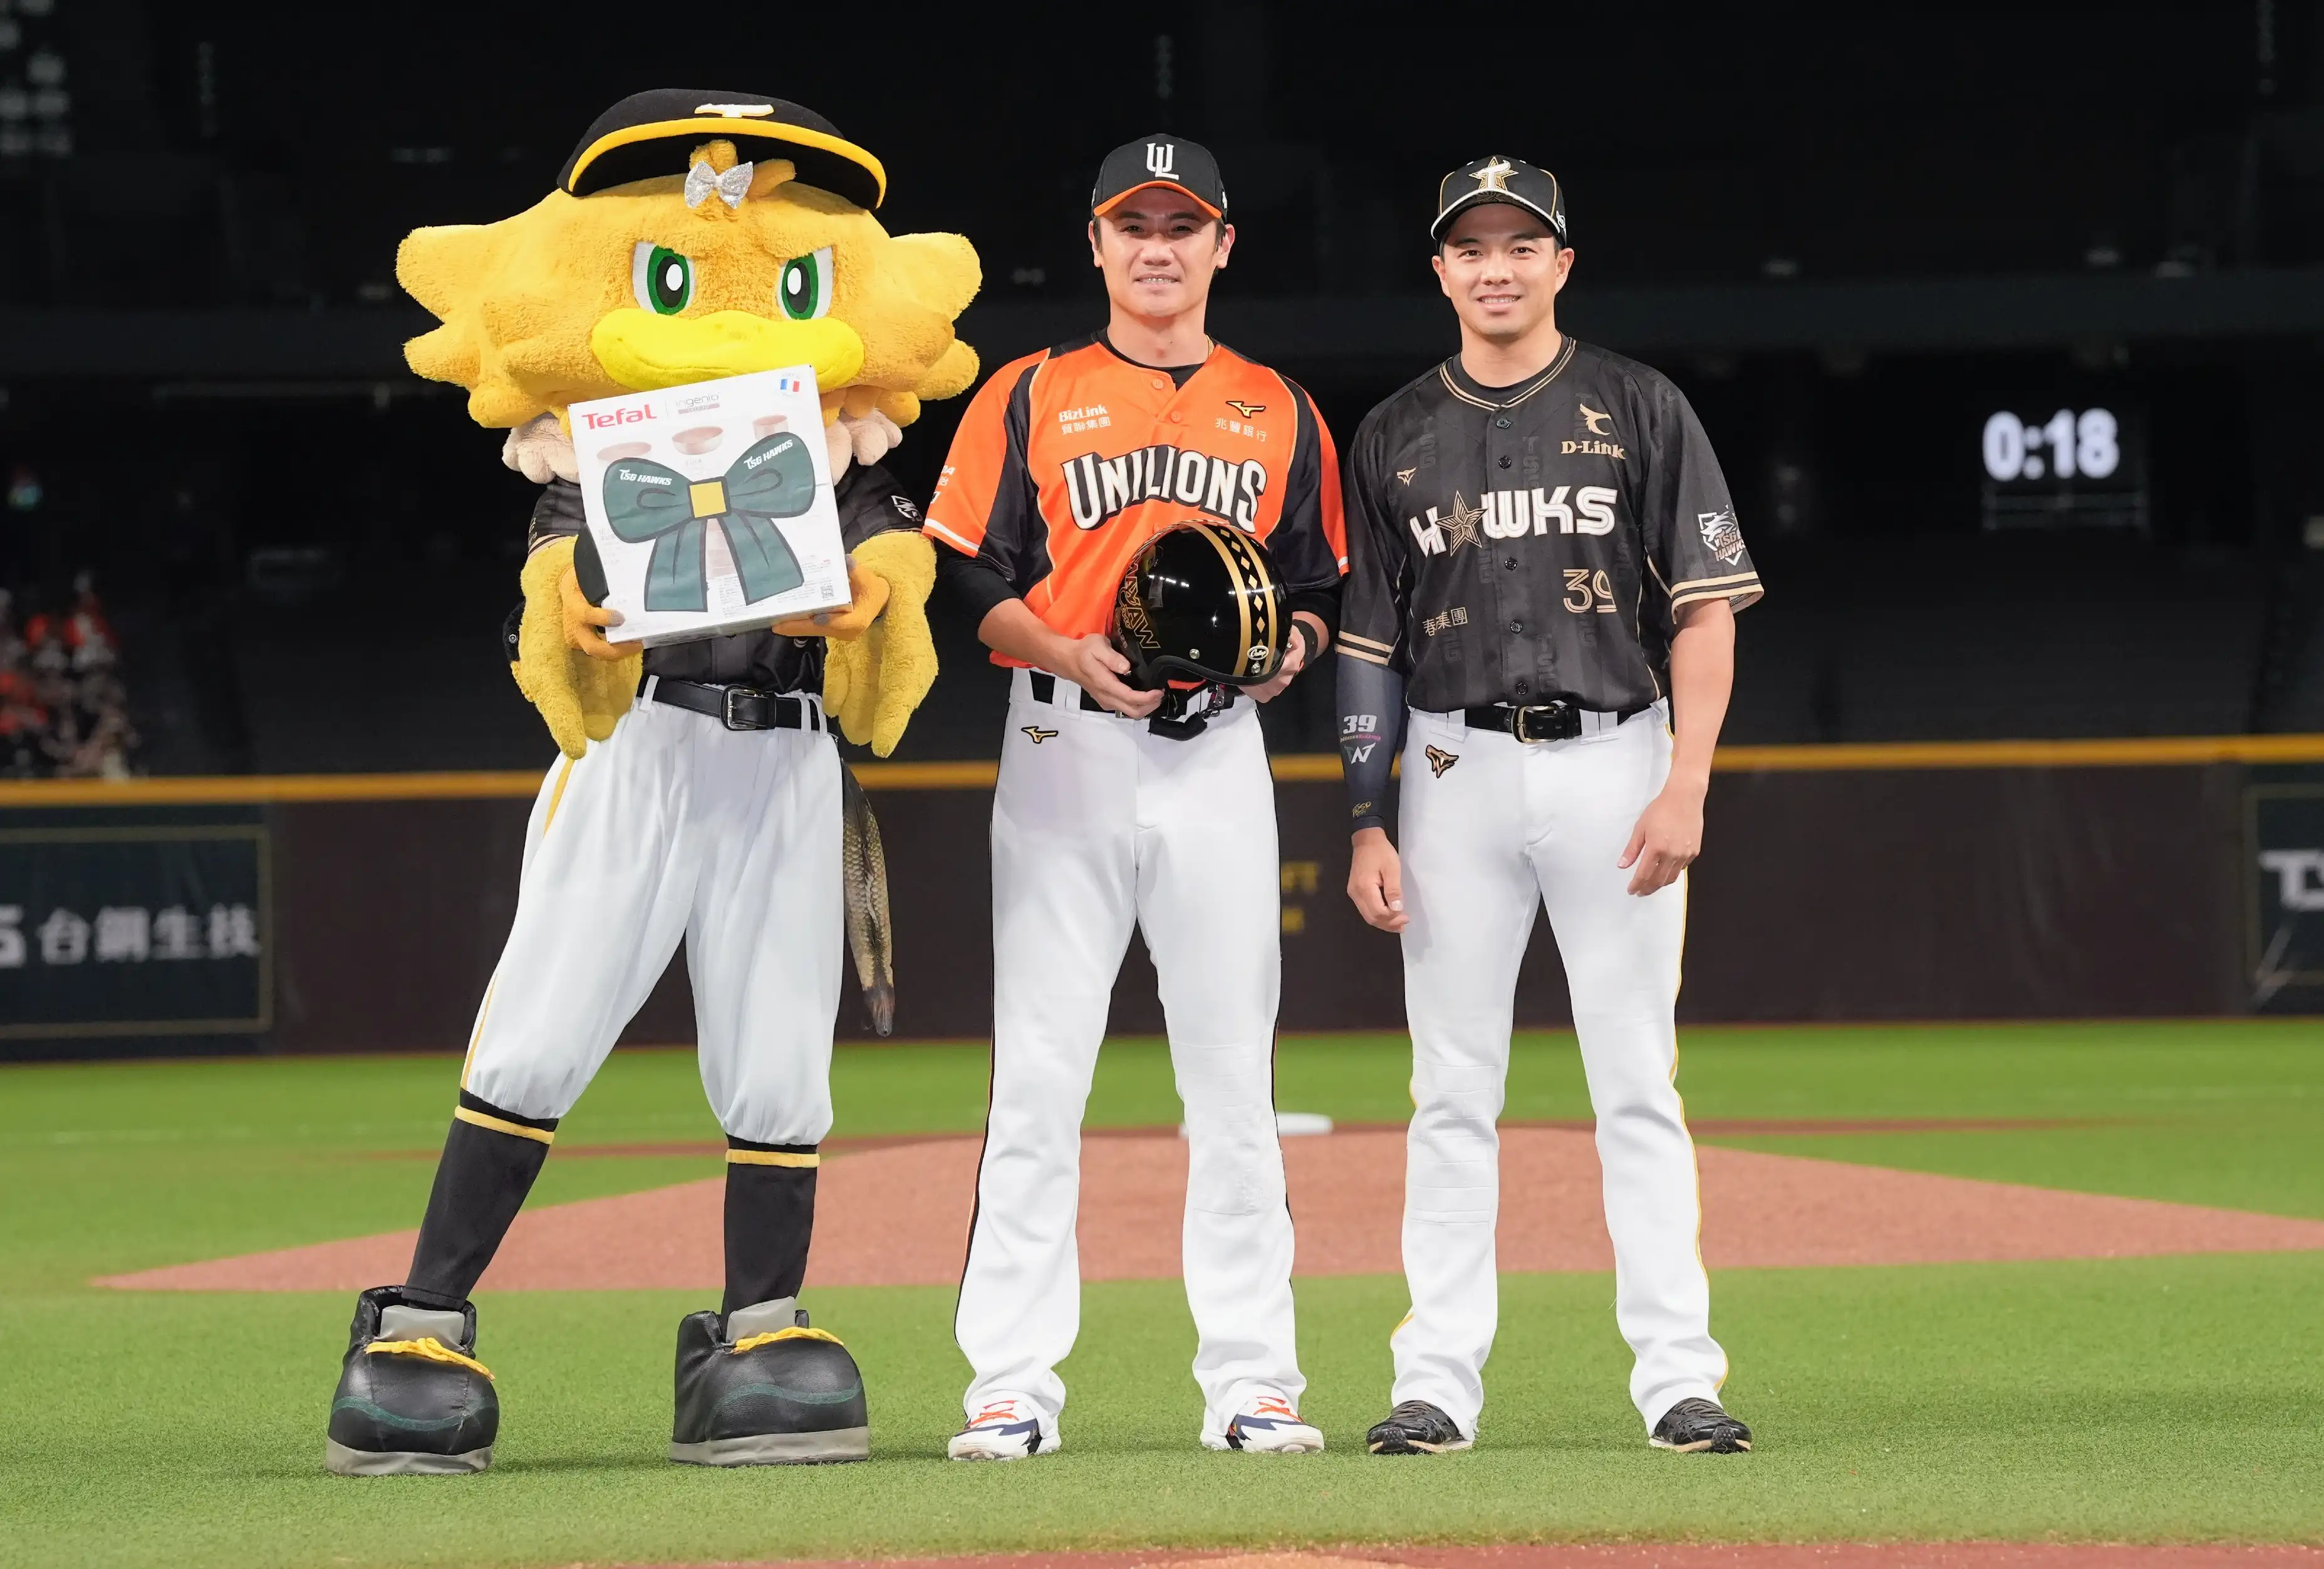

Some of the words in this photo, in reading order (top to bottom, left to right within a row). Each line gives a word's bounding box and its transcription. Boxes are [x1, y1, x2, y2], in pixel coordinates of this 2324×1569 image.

[676, 394, 719, 408] ingenio
[1059, 404, 1108, 423] BizLink
[581, 404, 658, 430] Tefal
[1215, 417, 1267, 442] 兆豐銀行
[743, 455, 762, 470] TSG
[762, 438, 794, 462] HAWKS
[1560, 440, 1627, 460] D-Link
[1983, 408, 2120, 481] 0:18
[618, 469, 638, 481] TSG
[637, 474, 673, 486] HAWKS
[1061, 444, 1268, 534] UNILIONS
[1409, 485, 1619, 558] HWKS
[1563, 569, 1617, 613] 39
[1342, 714, 1377, 735] 39
